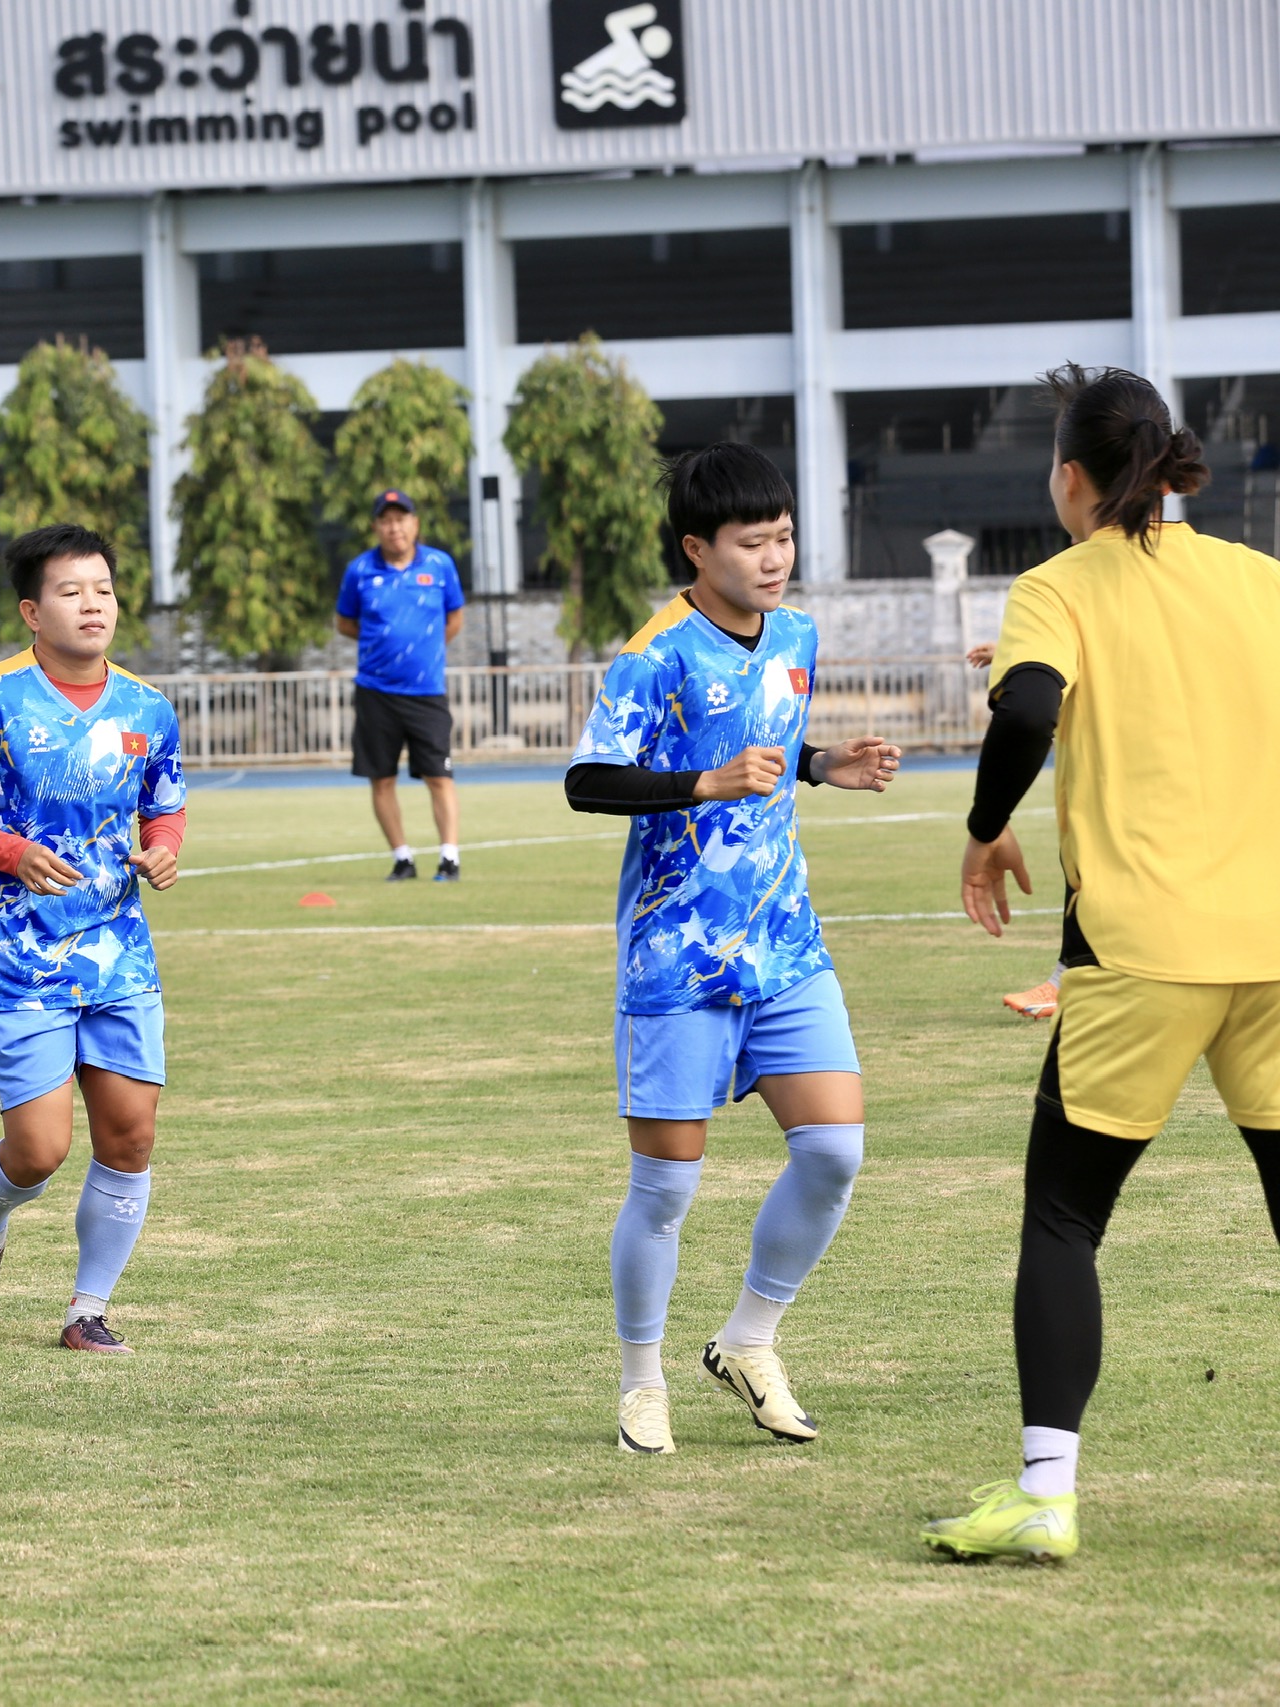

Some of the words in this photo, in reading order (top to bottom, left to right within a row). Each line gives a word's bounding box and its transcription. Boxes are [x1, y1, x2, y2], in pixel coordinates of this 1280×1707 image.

[55, 0, 473, 97] สระว่ายนำ
[60, 96, 324, 149] swimming
[357, 91, 475, 145] pool
